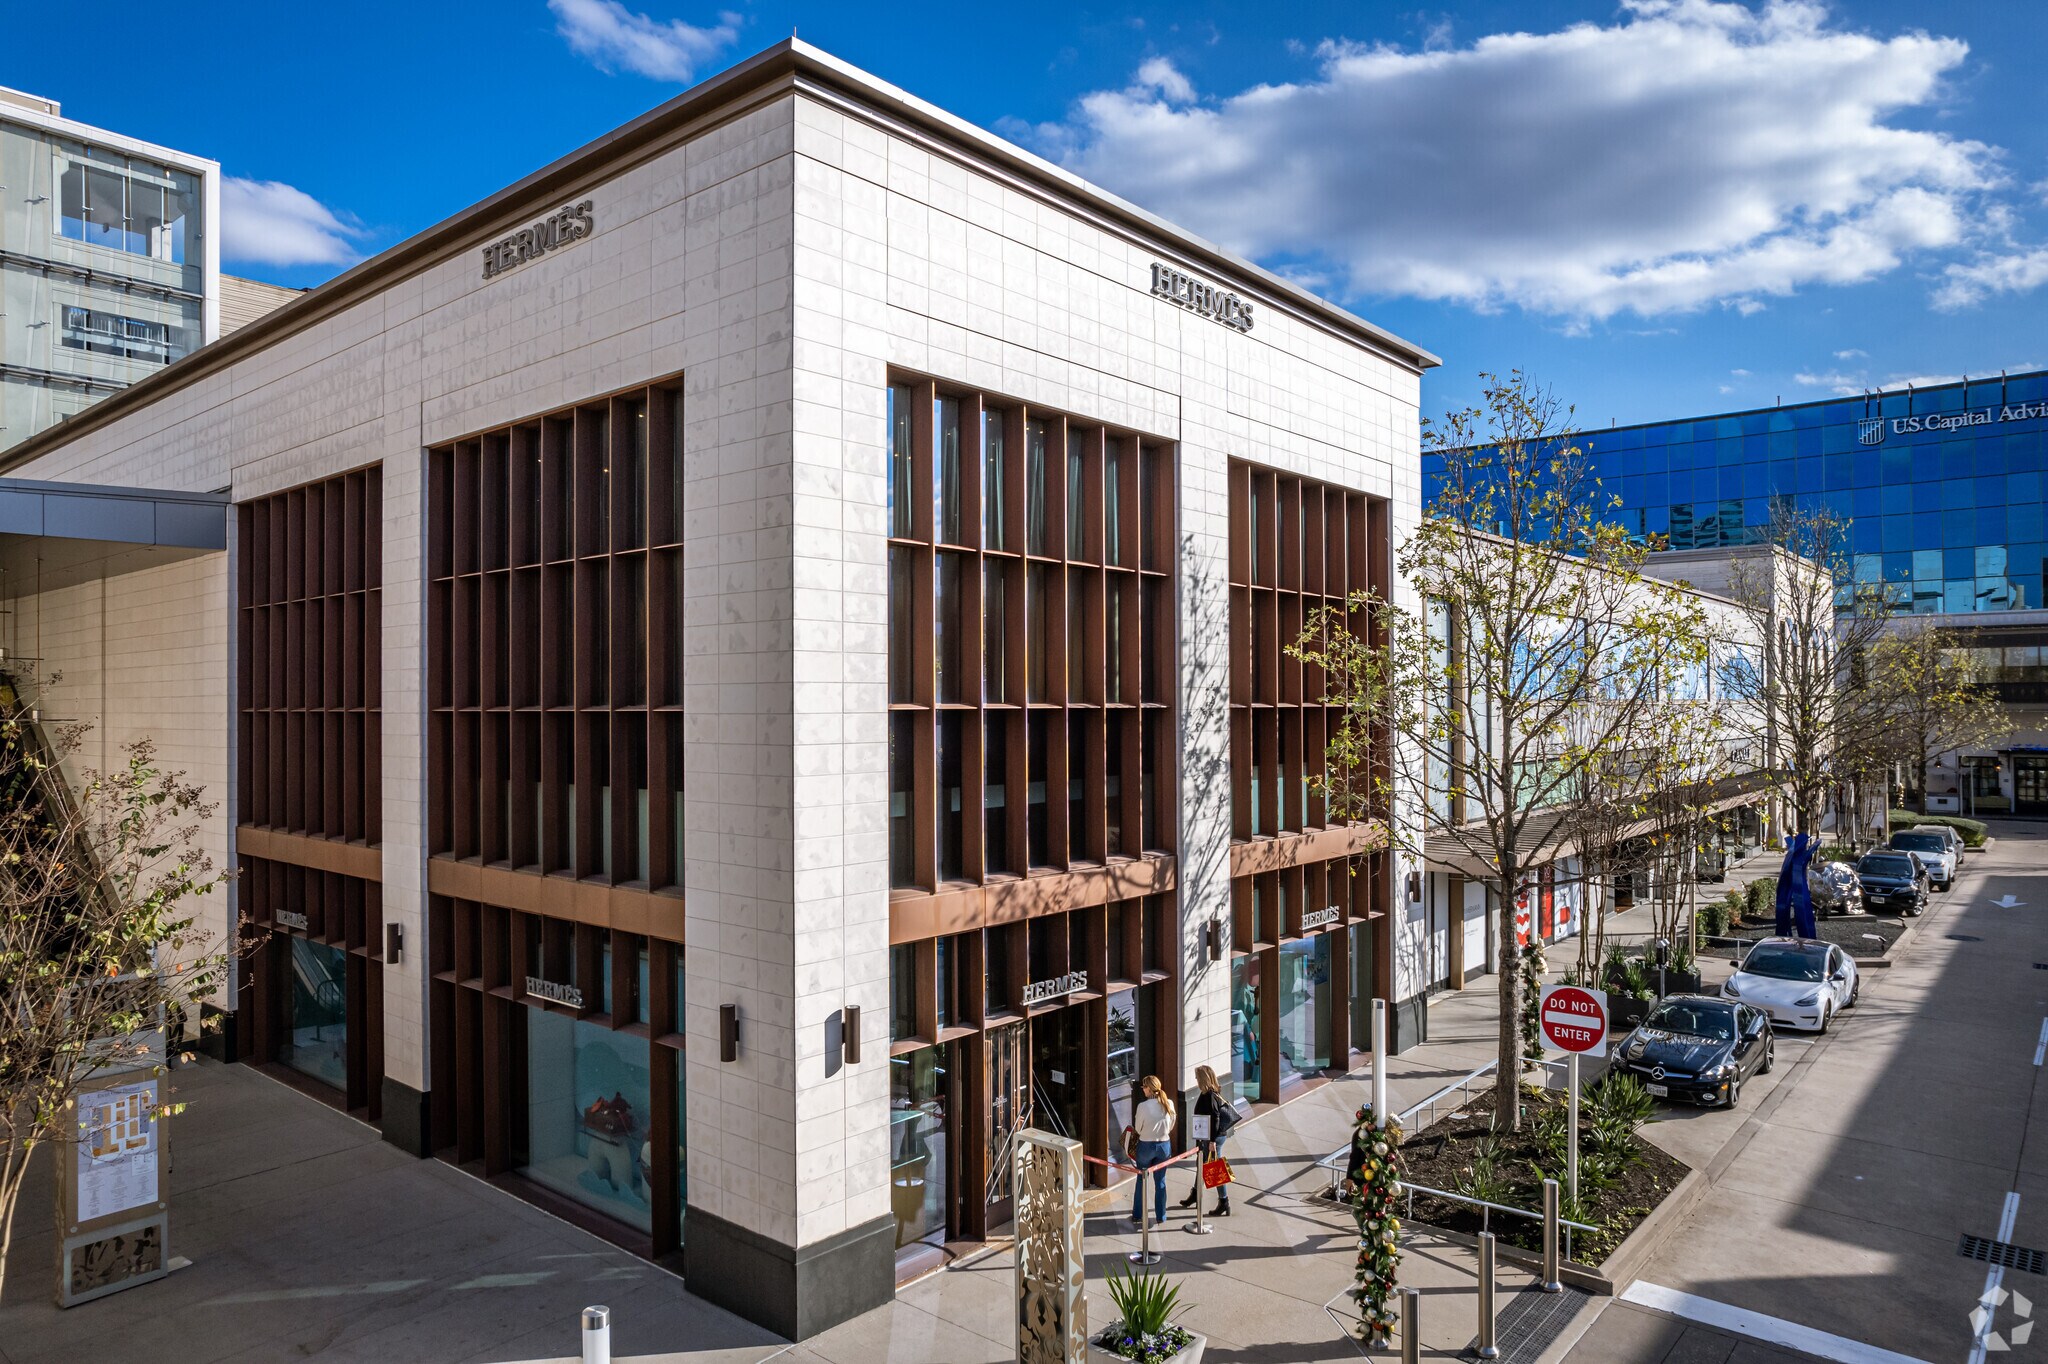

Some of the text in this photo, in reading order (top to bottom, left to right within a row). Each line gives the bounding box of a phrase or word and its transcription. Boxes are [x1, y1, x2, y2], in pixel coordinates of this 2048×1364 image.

[482, 200, 593, 280] HERMÈS
[1150, 262, 1254, 333] HERMÈS
[1925, 408, 1993, 432] Capital
[1997, 402, 2048, 422] Advi
[1022, 970, 1088, 1003] HERMÈS
[1550, 998, 1596, 1014] DO NOT
[1554, 1026, 1591, 1042] ENTER
